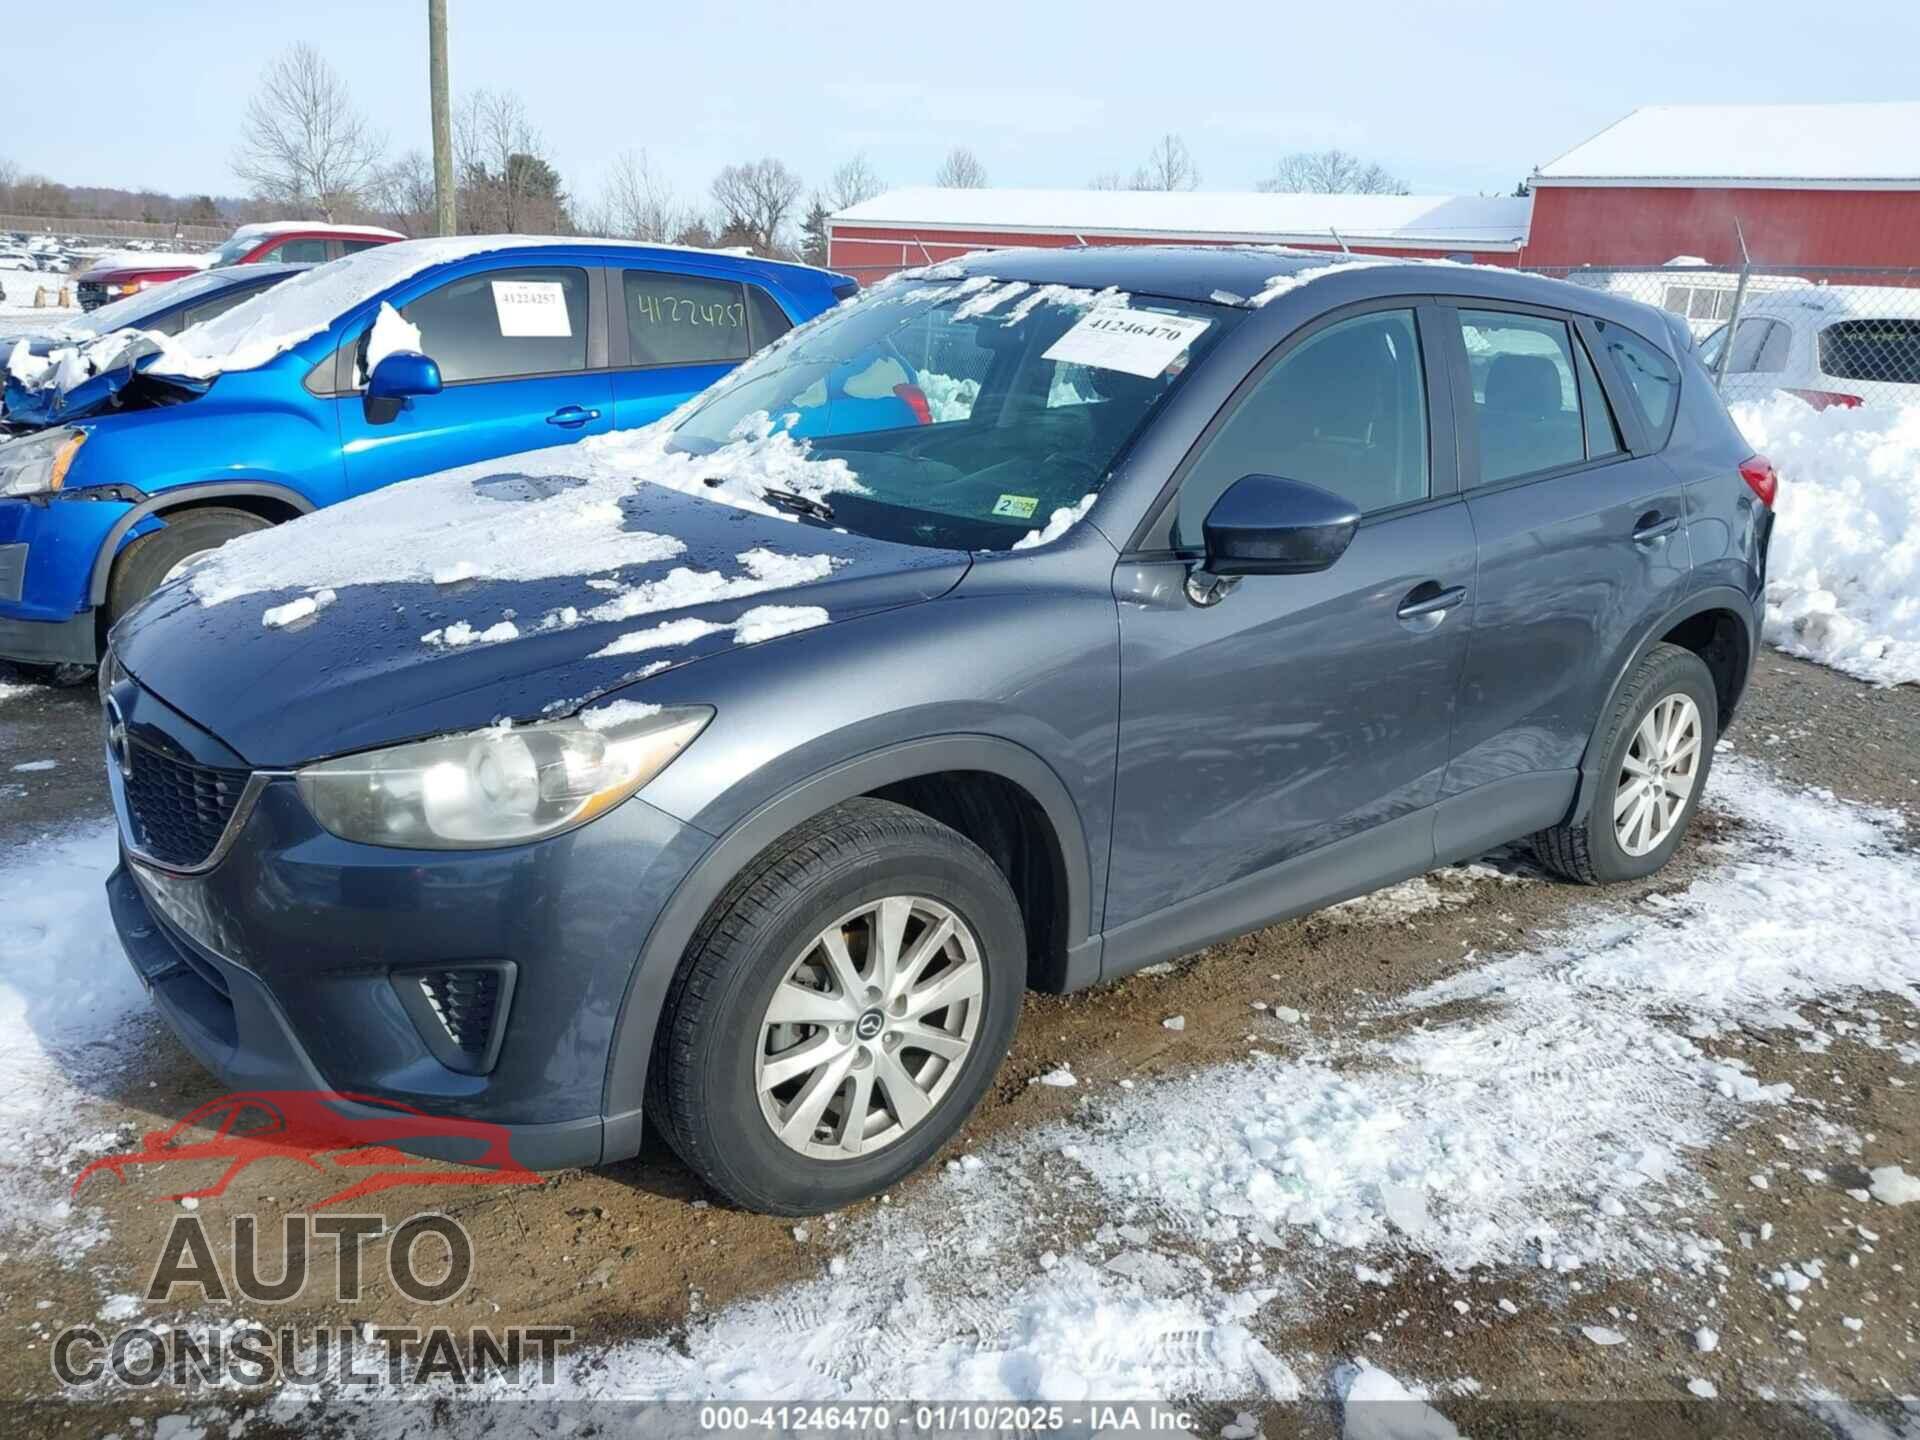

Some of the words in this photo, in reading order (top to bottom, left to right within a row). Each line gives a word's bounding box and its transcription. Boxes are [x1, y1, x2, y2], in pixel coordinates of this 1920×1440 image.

[638, 294, 744, 327] 41224257
[1088, 318, 1182, 341] 41246470
[999, 499, 1012, 512] 2
